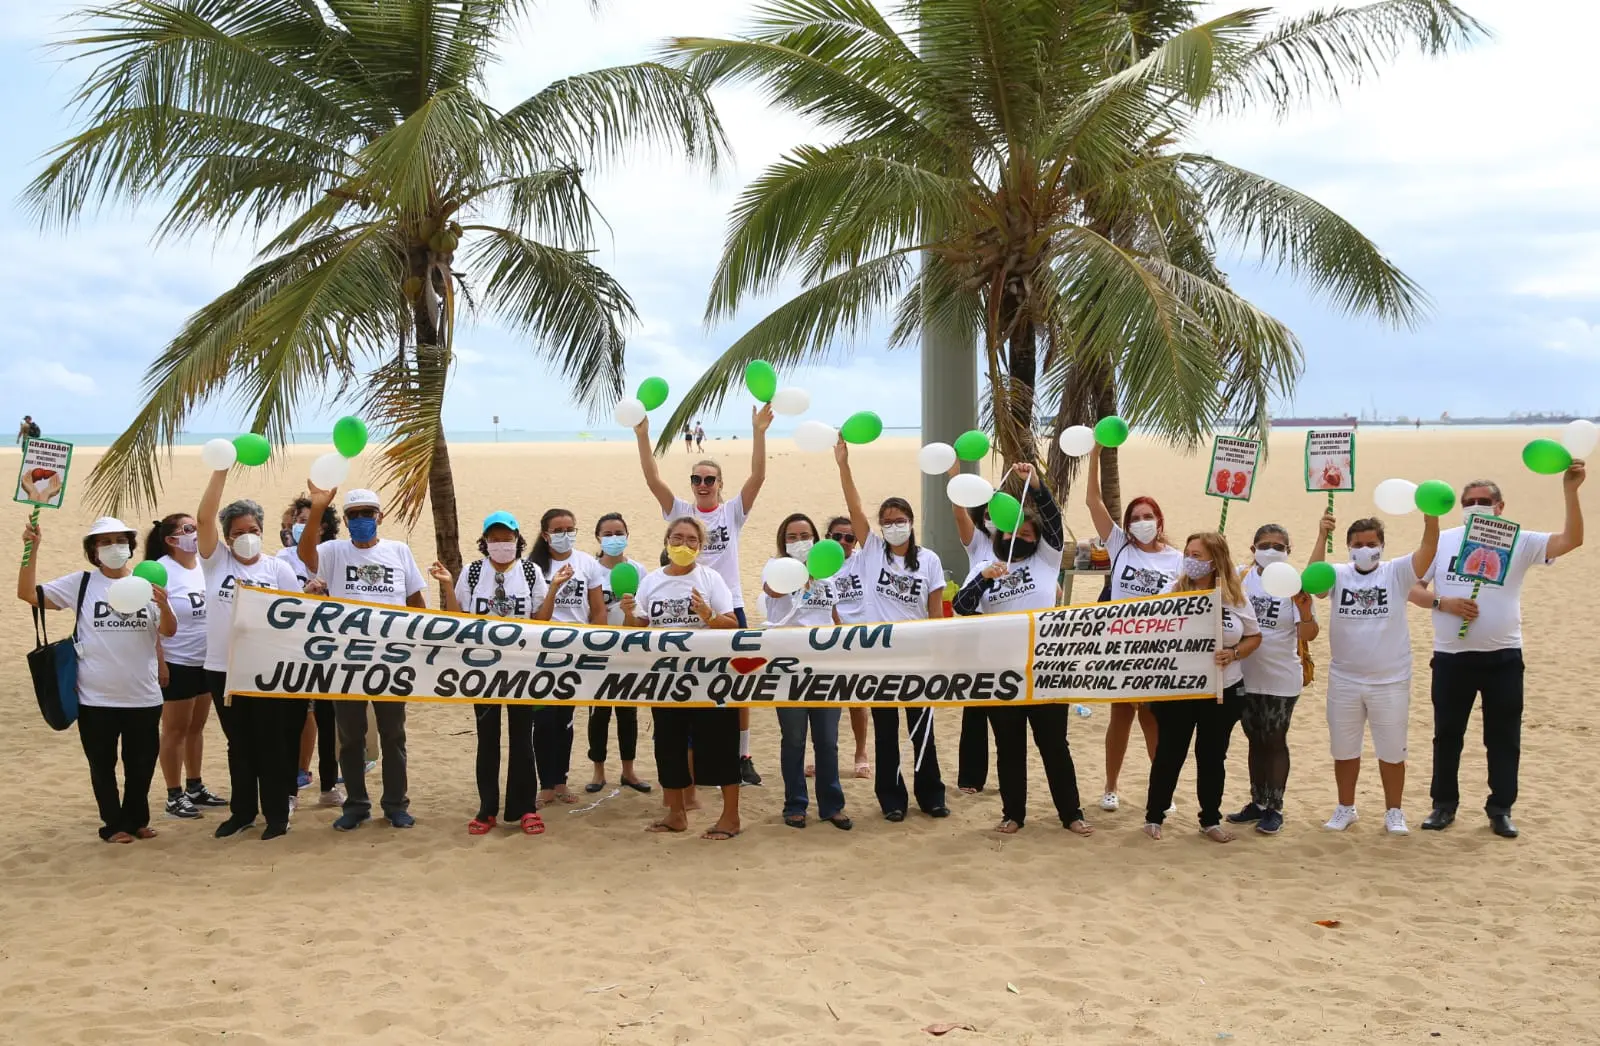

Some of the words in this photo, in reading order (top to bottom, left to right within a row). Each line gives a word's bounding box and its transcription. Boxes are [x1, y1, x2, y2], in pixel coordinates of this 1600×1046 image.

[345, 583, 356, 591] DE
[356, 584, 395, 593] CORAÇÃO
[876, 585, 884, 593] DE
[886, 588, 918, 604] CORAÇÃO
[988, 594, 998, 602] DE
[999, 583, 1036, 599] CORAÇÃO
[1039, 596, 1213, 621] PATROCINADORES:
[1339, 607, 1349, 615] DE
[1350, 607, 1389, 616] CORAÇÃO
[94, 620, 105, 628] DE
[107, 620, 147, 629] CORAÇÃO
[1039, 621, 1105, 638] UNIFOR
[540, 627, 694, 652] DOAR
[808, 623, 894, 650] UM
[304, 636, 502, 667] GESTO
[535, 652, 611, 670] DE
[1034, 641, 1101, 657] CENTRAL
[1105, 640, 1122, 655] DE
[1123, 638, 1216, 655] TRANSPLANTE
[1032, 660, 1080, 672] AVINE
[1084, 657, 1178, 672] COMERCIAL
[254, 661, 416, 696] JUNTOS
[434, 668, 582, 700] SOMOS
[593, 672, 699, 702] MAIS
[707, 672, 780, 705] QUE
[788, 670, 1024, 701] VENCEDORES
[1034, 675, 1117, 690] MEMORIAL
[1122, 674, 1208, 690] FORTALEZA
